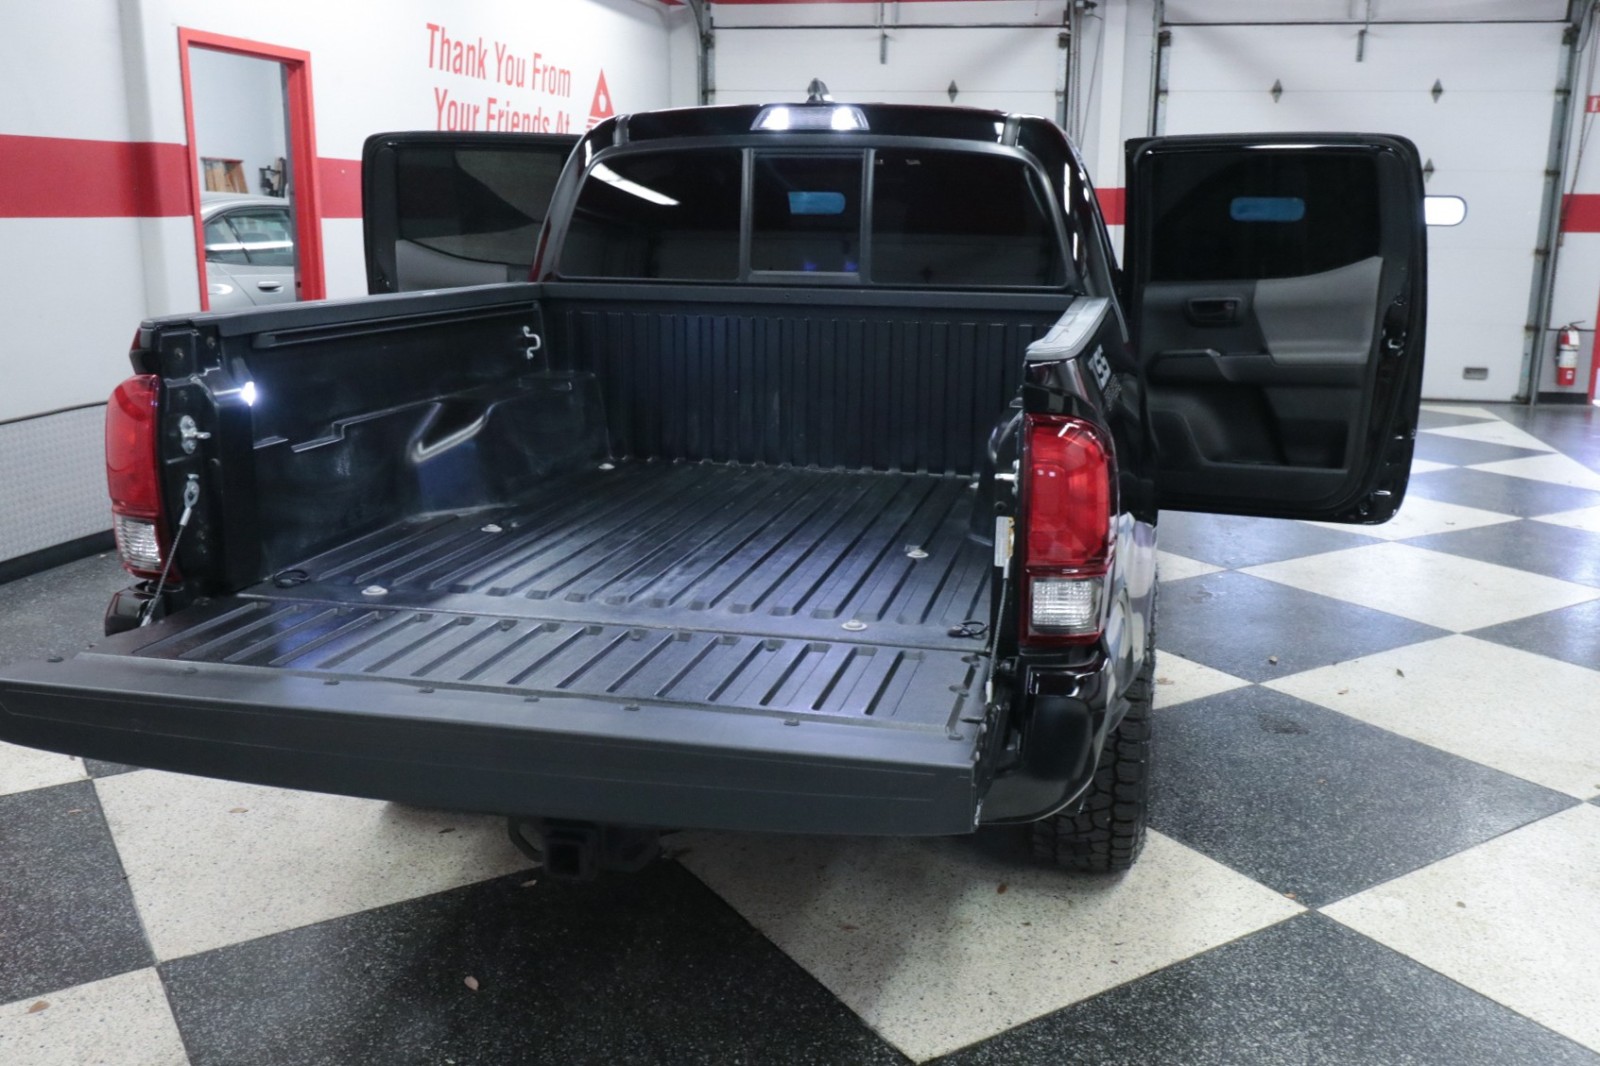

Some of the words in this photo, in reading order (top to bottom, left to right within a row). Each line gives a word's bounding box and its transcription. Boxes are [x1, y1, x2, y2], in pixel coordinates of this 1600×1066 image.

[426, 22, 487, 80] Thank
[495, 41, 526, 88] You
[531, 52, 572, 98] From
[434, 87, 480, 132] Your
[486, 97, 550, 133] Friends
